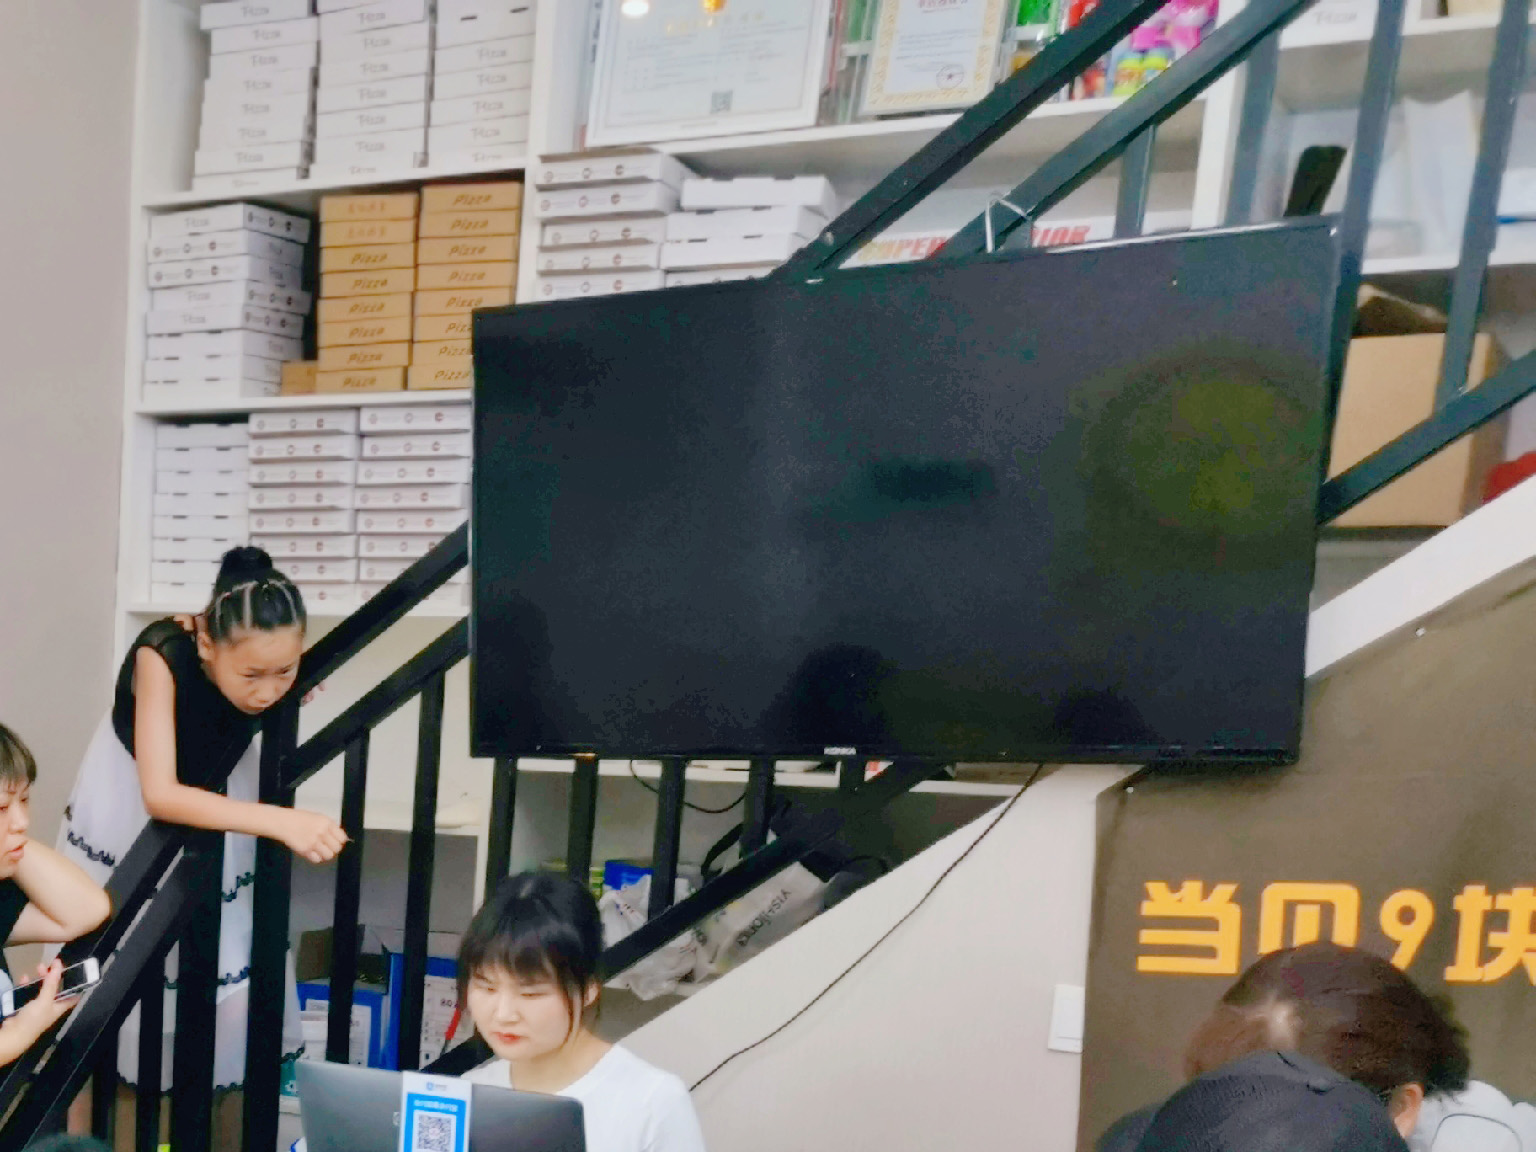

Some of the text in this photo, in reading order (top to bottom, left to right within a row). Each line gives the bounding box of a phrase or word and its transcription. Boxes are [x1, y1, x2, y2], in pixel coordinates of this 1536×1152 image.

[452, 194, 492, 206] Pizza
[450, 219, 489, 231] Pizza
[448, 245, 486, 257] Pizza
[351, 253, 388, 265] Pizza
[448, 271, 486, 282] Pizza
[352, 279, 388, 290] Pizza
[349, 302, 385, 314] Pizza
[446, 297, 484, 308] Pizza
[349, 327, 385, 339] Pizza
[445, 322, 472, 334] Piz
[347, 353, 383, 364] Pizza
[343, 377, 376, 388] Pizza
